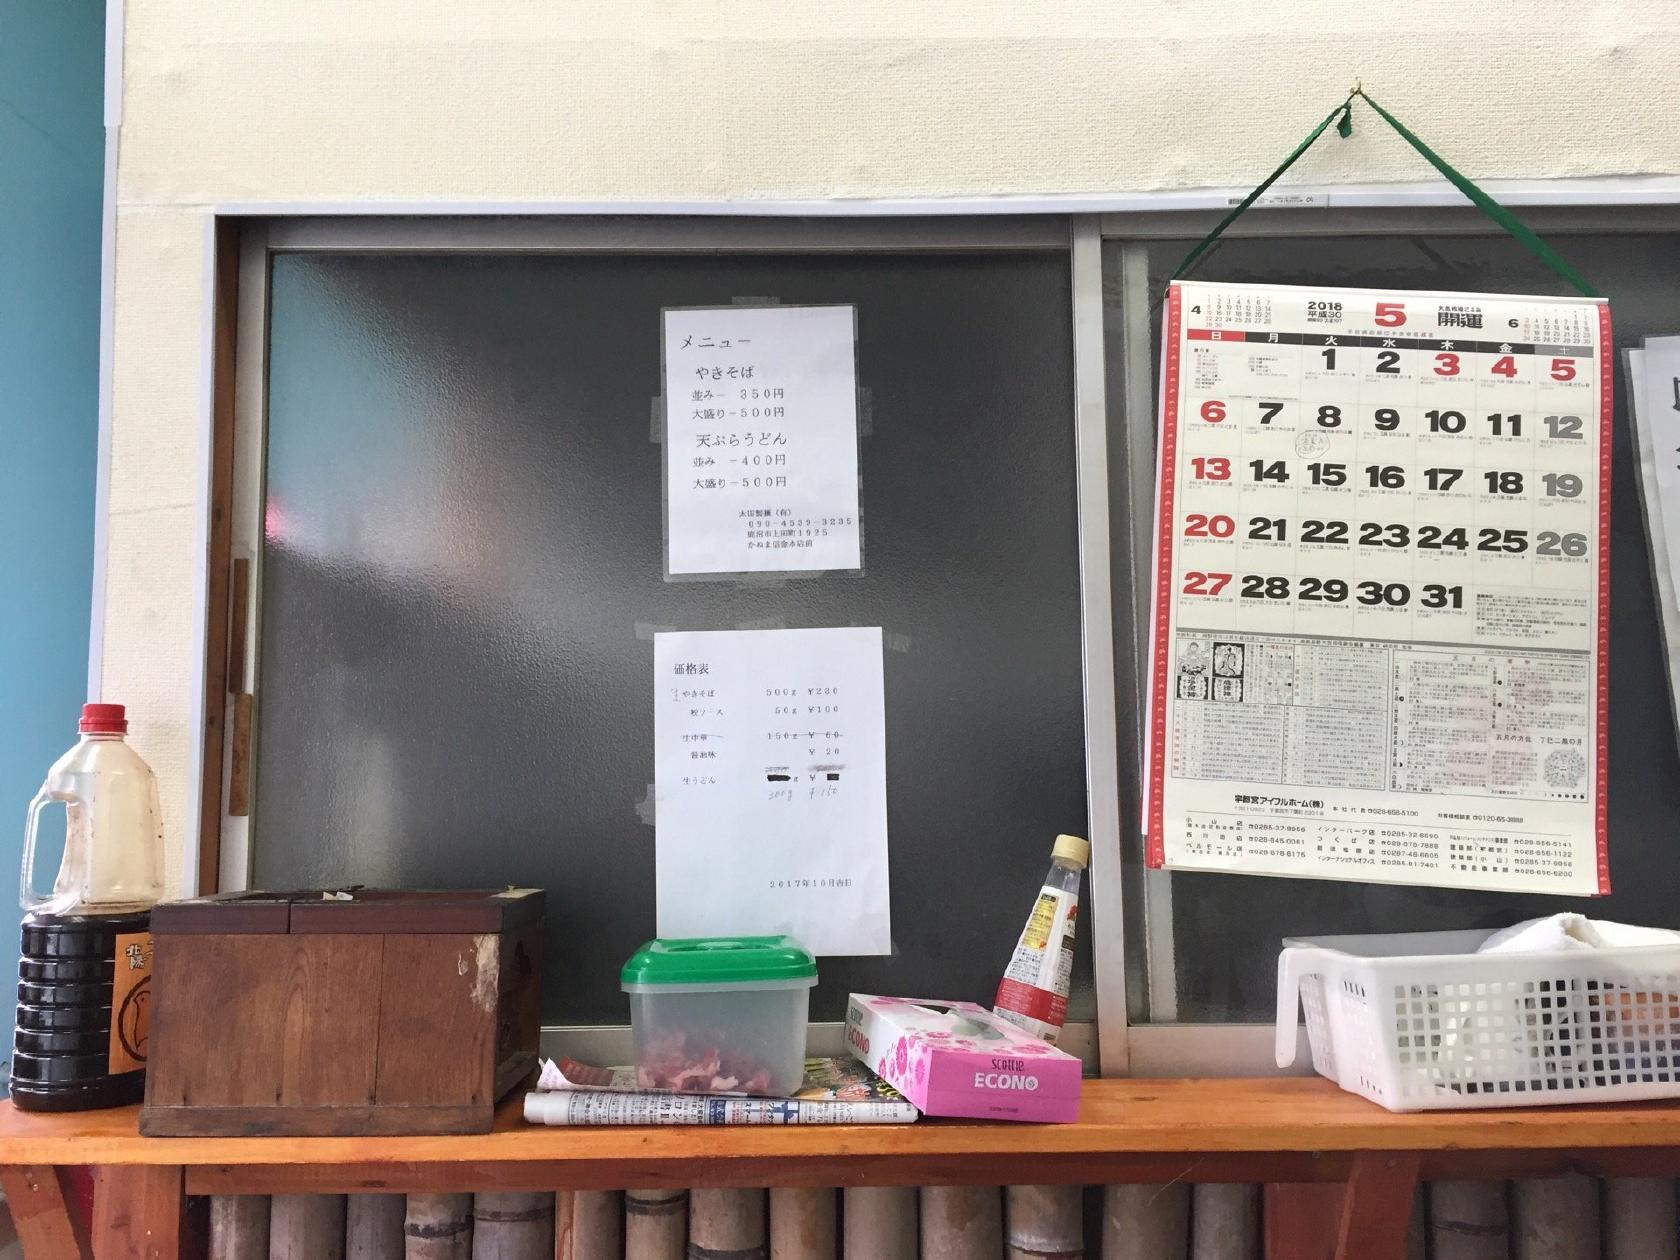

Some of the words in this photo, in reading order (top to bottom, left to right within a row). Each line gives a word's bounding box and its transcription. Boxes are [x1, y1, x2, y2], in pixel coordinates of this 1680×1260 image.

[1191, 305, 1201, 315] 4
[1308, 301, 1342, 311] 2018
[1308, 311, 1342, 319] 平成30
[1374, 302, 1407, 328] 5
[1438, 312, 1483, 329] 開運
[1508, 319, 1519, 328] 6
[681, 334, 751, 350] メニュー
[1211, 332, 1222, 341] 日
[1268, 333, 1279, 343] 月
[1325, 336, 1338, 346] 火
[1382, 338, 1396, 348] 水
[1441, 340, 1454, 351] 木
[1499, 343, 1512, 354] 金
[696, 366, 754, 380] やきそば
[1322, 349, 1335, 370] 1
[1376, 351, 1400, 373] 2
[1434, 354, 1460, 375] 3
[1492, 357, 1517, 377] 4
[1551, 359, 1576, 381] 5
[1201, 401, 1226, 422] 6
[1259, 403, 1283, 424] 7
[1317, 406, 1341, 427] 8
[1375, 409, 1400, 430] 9
[1425, 410, 1466, 433] 10
[1487, 414, 1521, 436] 11
[1544, 416, 1583, 439] 12
[696, 432, 787, 447] 天ぷらうどん
[1192, 458, 1231, 480] 13
[1250, 460, 1289, 483] 14
[1307, 463, 1347, 486] 15
[1365, 466, 1405, 488] 16
[1424, 468, 1463, 491] 17
[1485, 471, 1523, 494] 18
[1542, 473, 1582, 497] 19
[1184, 514, 1235, 537] 20
[1248, 517, 1286, 541] 21
[1301, 520, 1348, 544] 22
[1359, 523, 1410, 547] 23
[1417, 526, 1469, 550] 24
[1477, 529, 1528, 553] 25
[1536, 532, 1587, 556] 26
[1183, 572, 1232, 595] 27
[1241, 575, 1290, 599] 28
[1298, 578, 1348, 602] 29
[1356, 581, 1410, 606] 30
[1421, 584, 1462, 609] 31
[674, 663, 709, 675] 価格表
[682, 689, 716, 698] やきそば
[992, 1059, 1024, 1071] scottie
[974, 1072, 1039, 1091] ECONO
